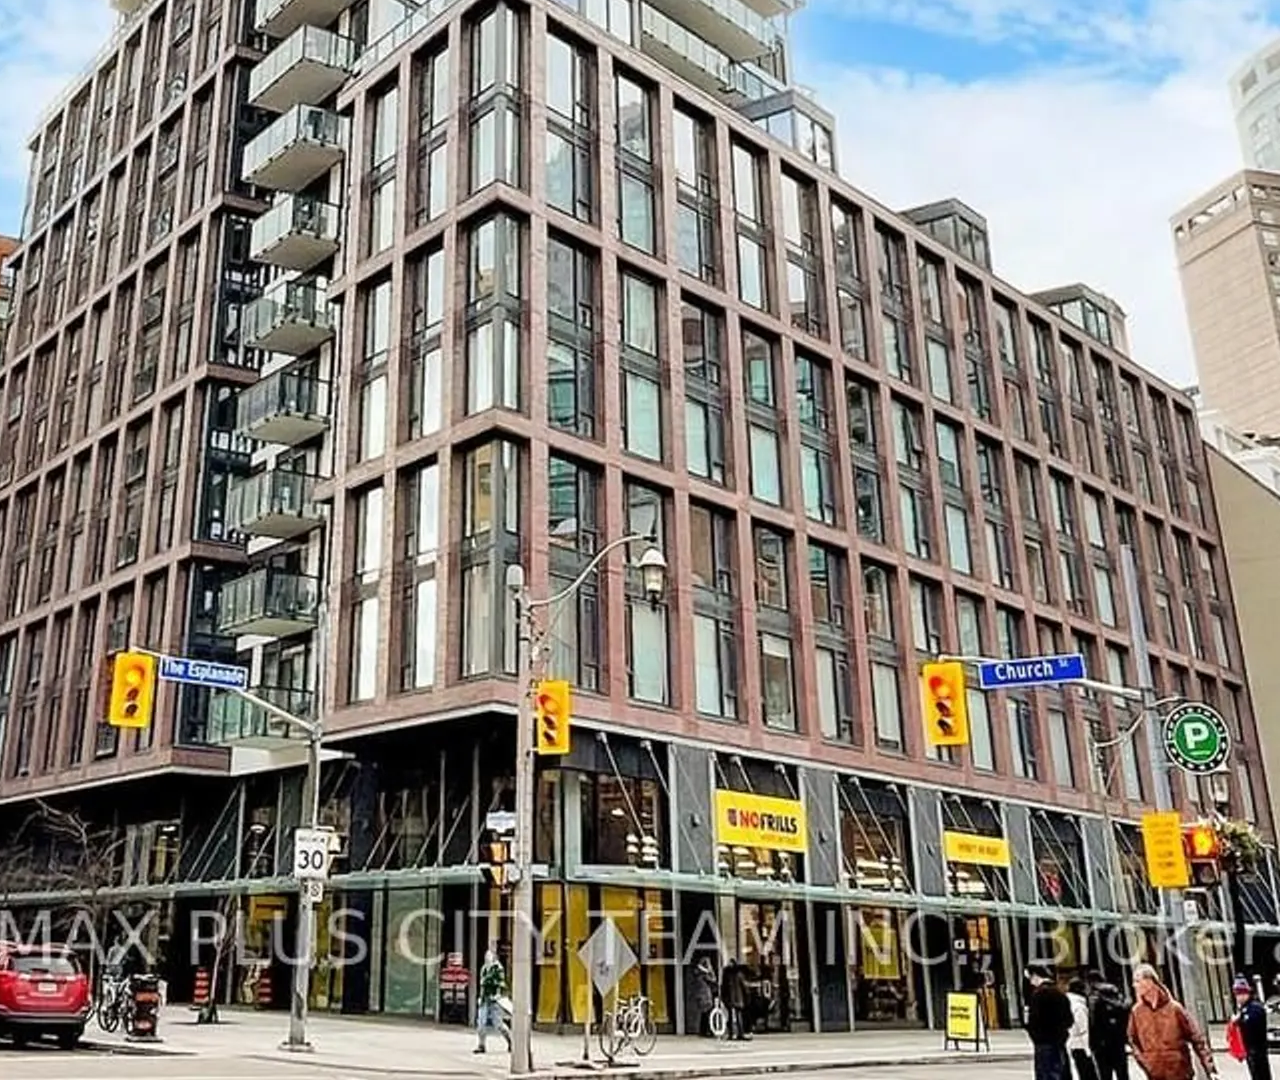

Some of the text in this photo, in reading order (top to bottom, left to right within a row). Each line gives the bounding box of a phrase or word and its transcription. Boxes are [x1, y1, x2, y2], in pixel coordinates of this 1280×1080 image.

[165, 659, 246, 684] The Esplanade
[995, 661, 1054, 680] Church
[1184, 721, 1209, 749] P
[298, 850, 324, 870] 30
